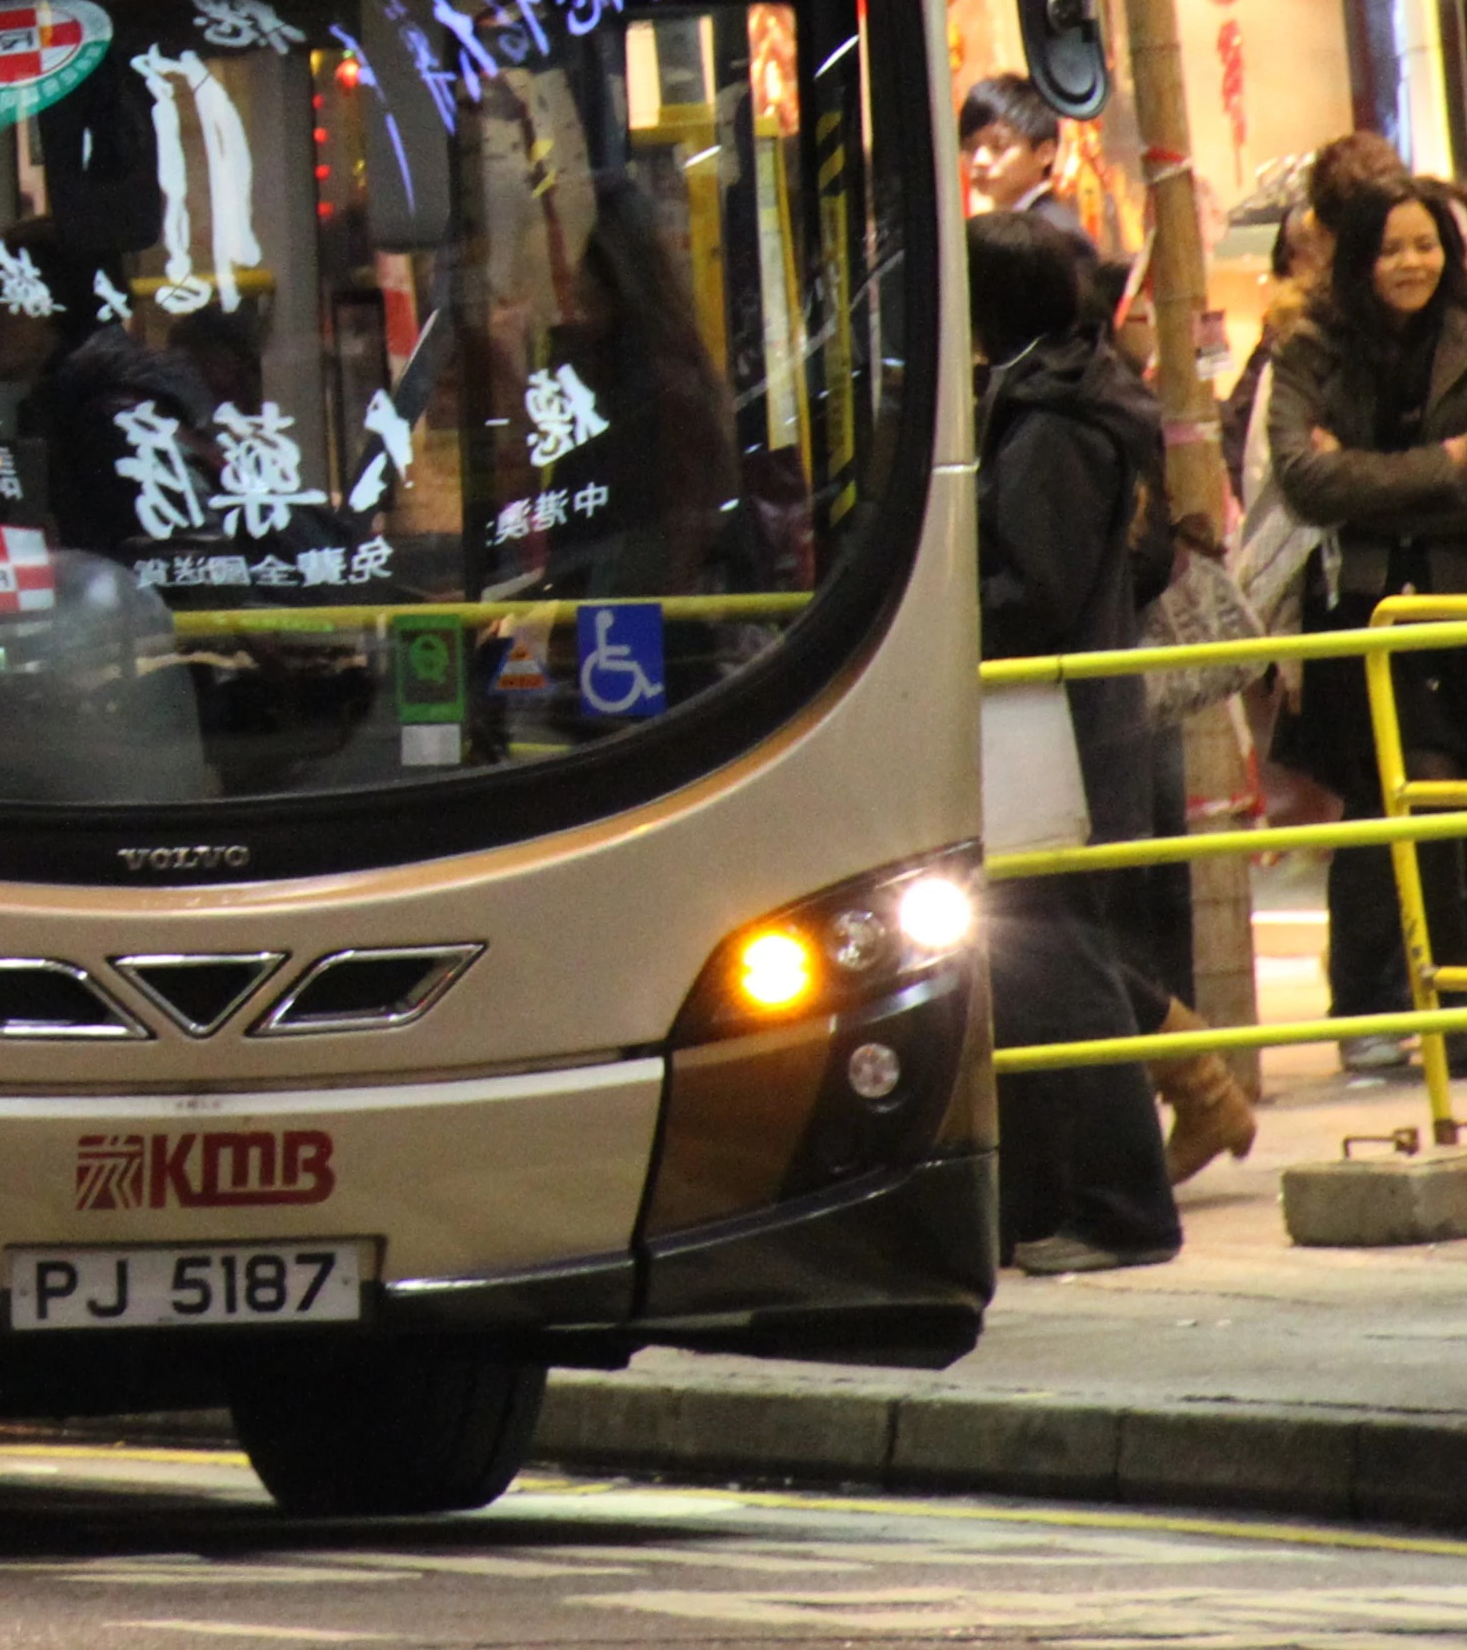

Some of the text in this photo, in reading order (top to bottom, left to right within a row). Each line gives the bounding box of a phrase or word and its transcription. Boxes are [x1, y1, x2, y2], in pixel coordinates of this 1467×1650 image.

[116, 844, 251, 871] VOLVO
[148, 1129, 337, 1209] KMB
[34, 1251, 337, 1321] PJ 5187
